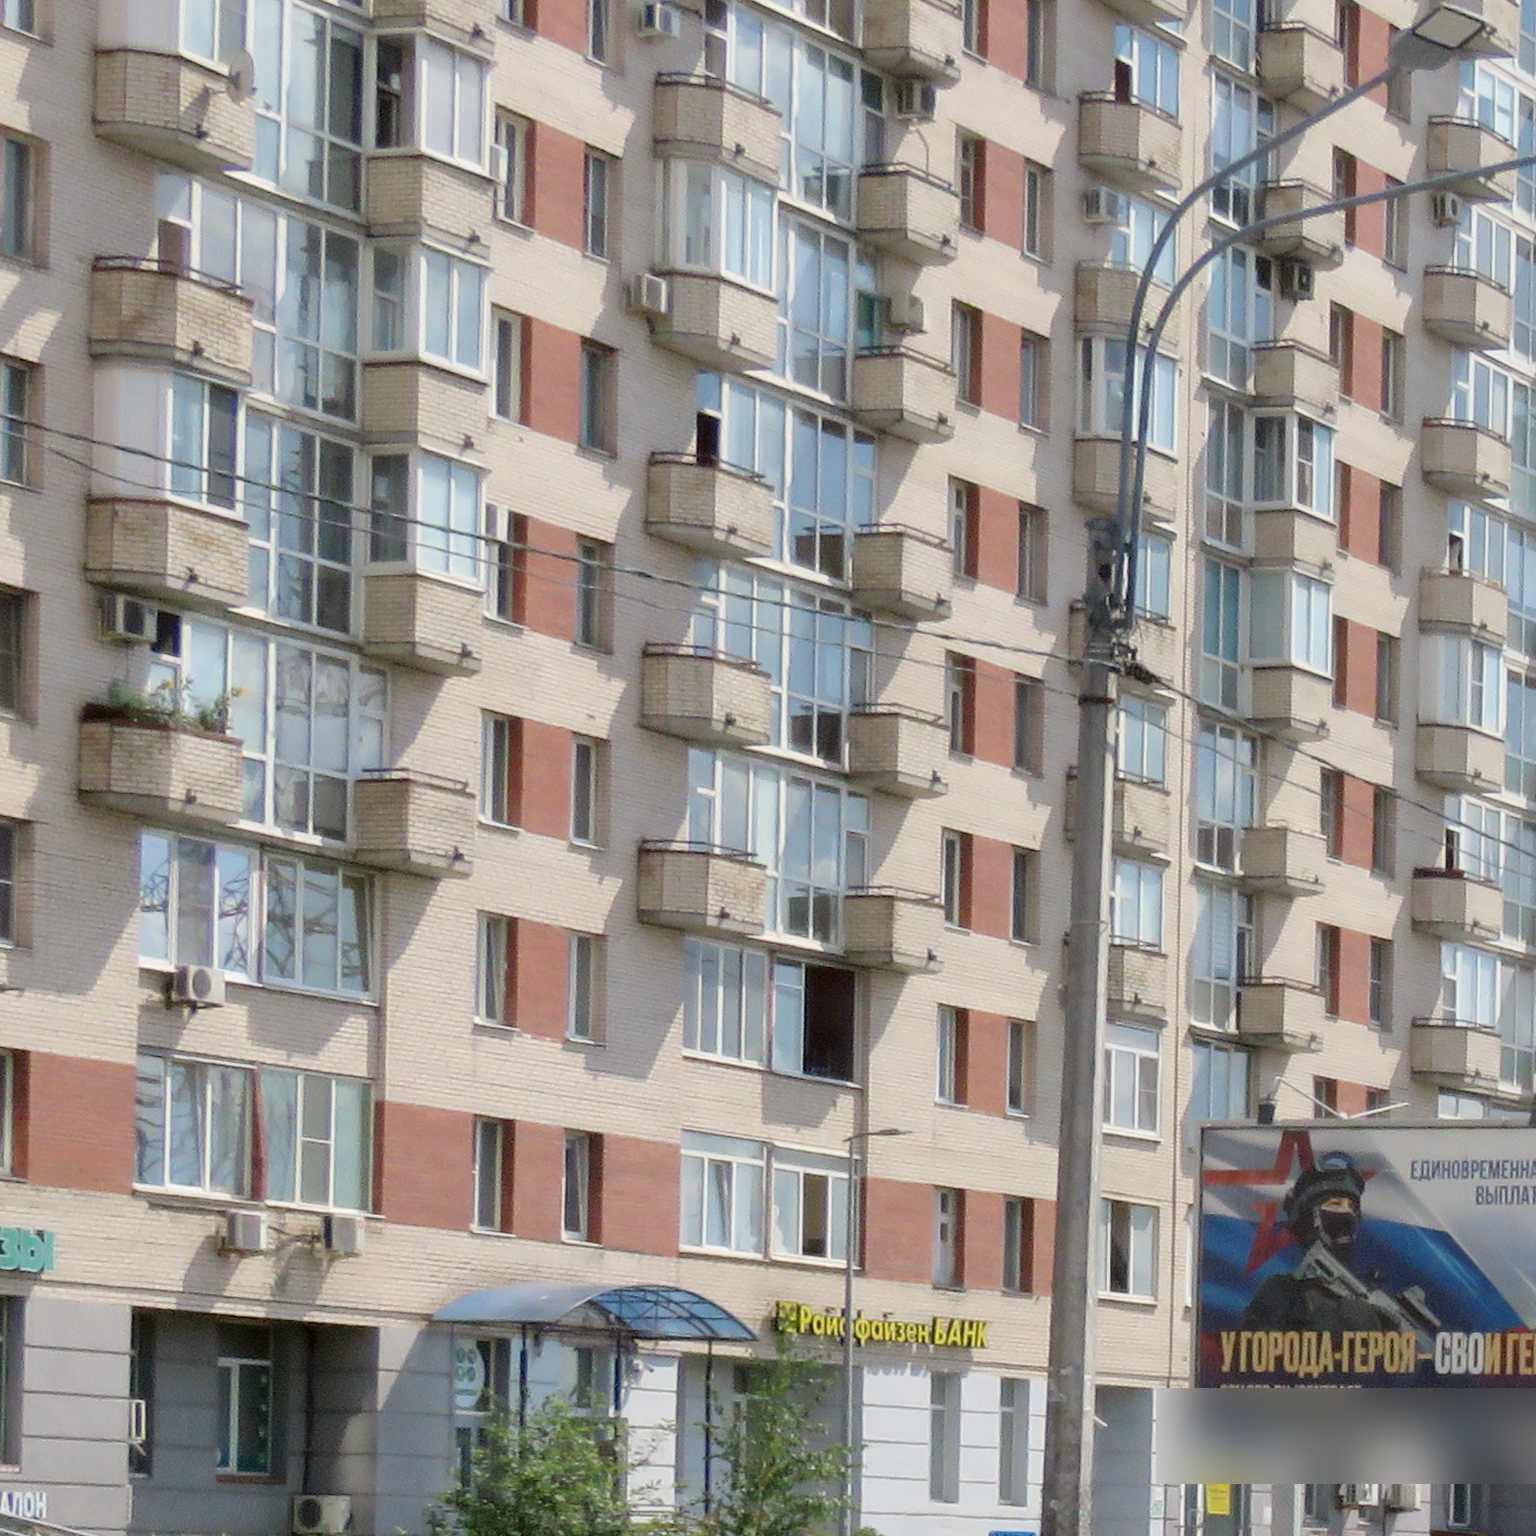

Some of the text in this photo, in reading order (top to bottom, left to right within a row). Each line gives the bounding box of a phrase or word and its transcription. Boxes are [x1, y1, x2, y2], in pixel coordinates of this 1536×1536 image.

[932, 1317, 990, 1349] БАНК
[1220, 1331, 1236, 1373] У
[1239, 1331, 1417, 1379] ГОРОДА-ГЕРОЯ
[1434, 1331, 1500, 1375] СВОИ
